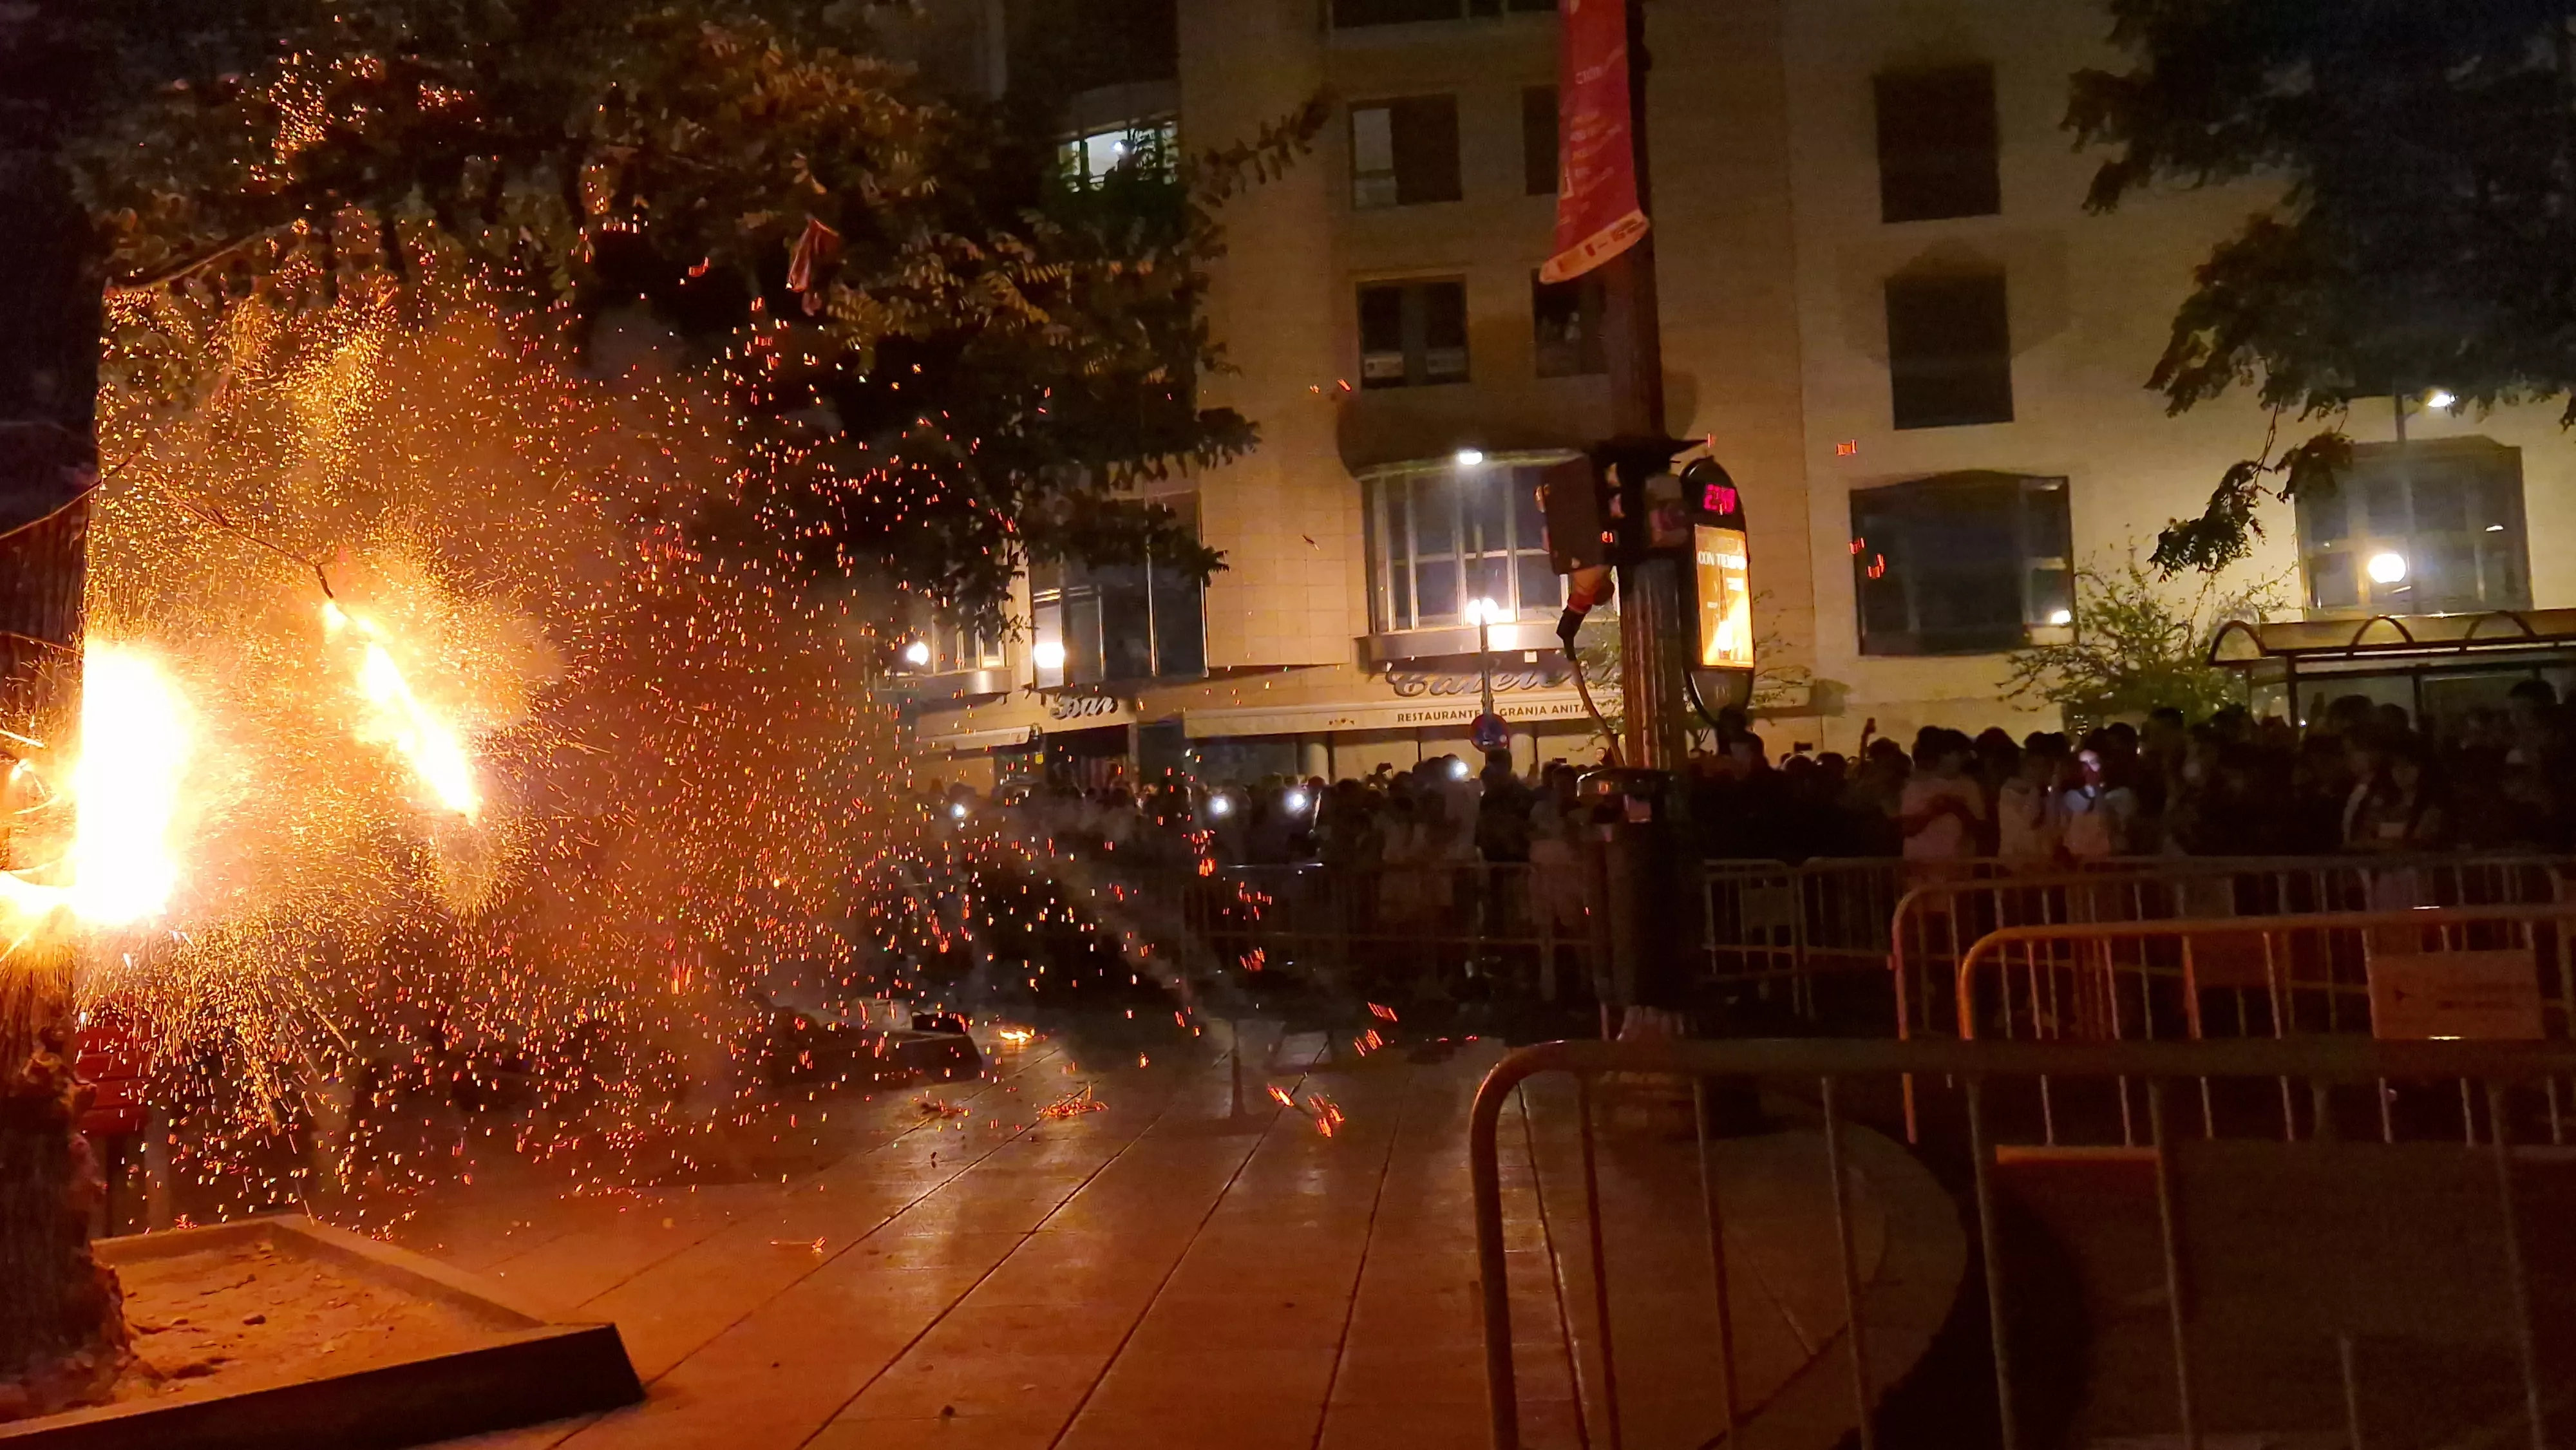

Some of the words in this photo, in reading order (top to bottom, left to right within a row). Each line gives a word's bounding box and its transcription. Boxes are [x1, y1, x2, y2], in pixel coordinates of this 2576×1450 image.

[1698, 551, 1715, 566] CON
[1397, 709, 1481, 722] RESTAURANTE
[1499, 706, 1547, 717] GRANJA
